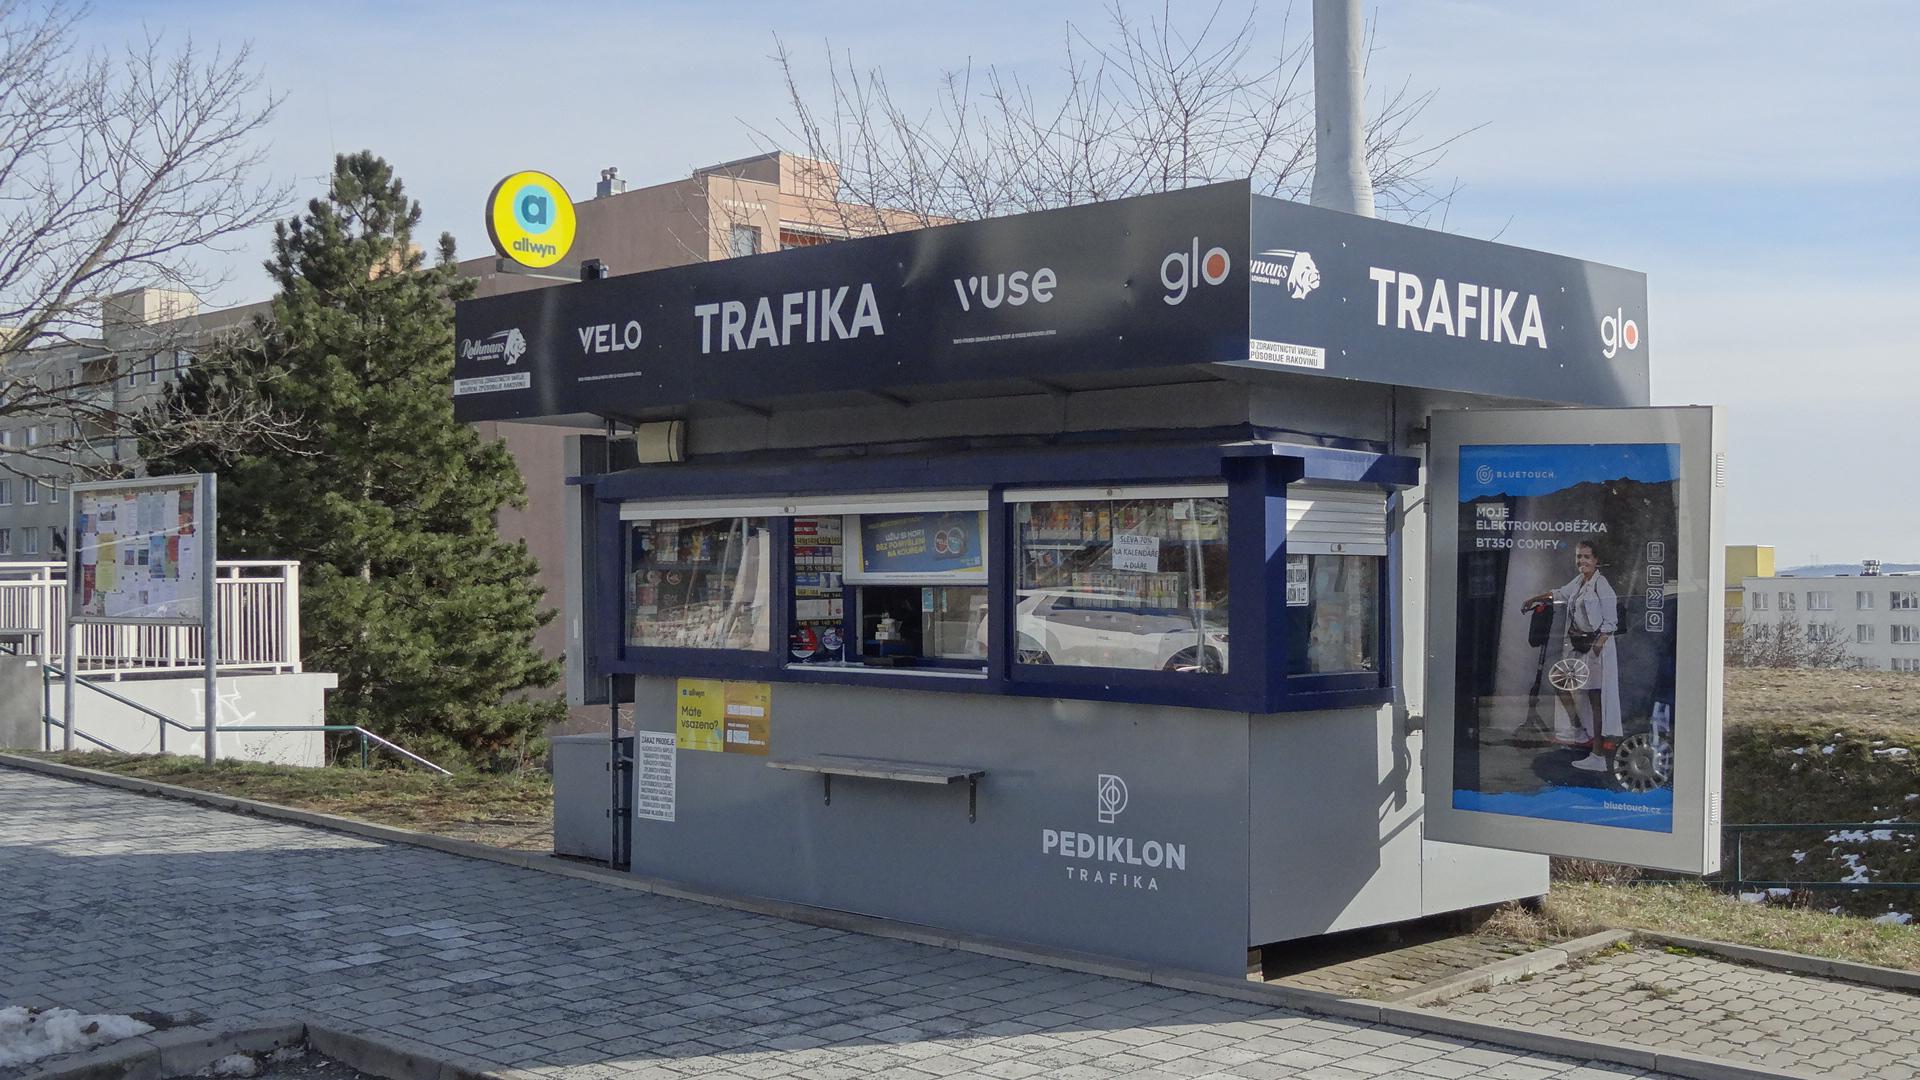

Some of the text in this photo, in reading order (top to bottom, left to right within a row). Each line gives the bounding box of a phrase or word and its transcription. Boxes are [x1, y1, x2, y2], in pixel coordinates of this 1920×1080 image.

[513, 237, 557, 258] allwyn
[1160, 236, 1231, 306] glo
[1369, 266, 1548, 349] TRAFIKA
[694, 282, 885, 354] TRAFIKA
[577, 320, 643, 355] VELO
[1600, 307, 1639, 359] glo
[461, 338, 505, 360] Rothmans
[1285, 354, 1318, 367] RAKOVINU
[1475, 507, 1510, 518] MOJE
[1475, 520, 1608, 533] ELEKTROKOLOBĚŽKA
[1119, 535, 1139, 544] SLEVA
[1475, 538, 1560, 550] BT350 COMFY
[681, 705, 702, 717] Máte
[681, 720, 719, 730] vsazeno?
[641, 735, 655, 745] ZÁKAZ
[655, 737, 675, 746] PRODEJE
[1603, 800, 1662, 815] bluetouch.cz
[1042, 828, 1186, 871] PEDIKLON
[1066, 866, 1159, 891] TRAFIKA
